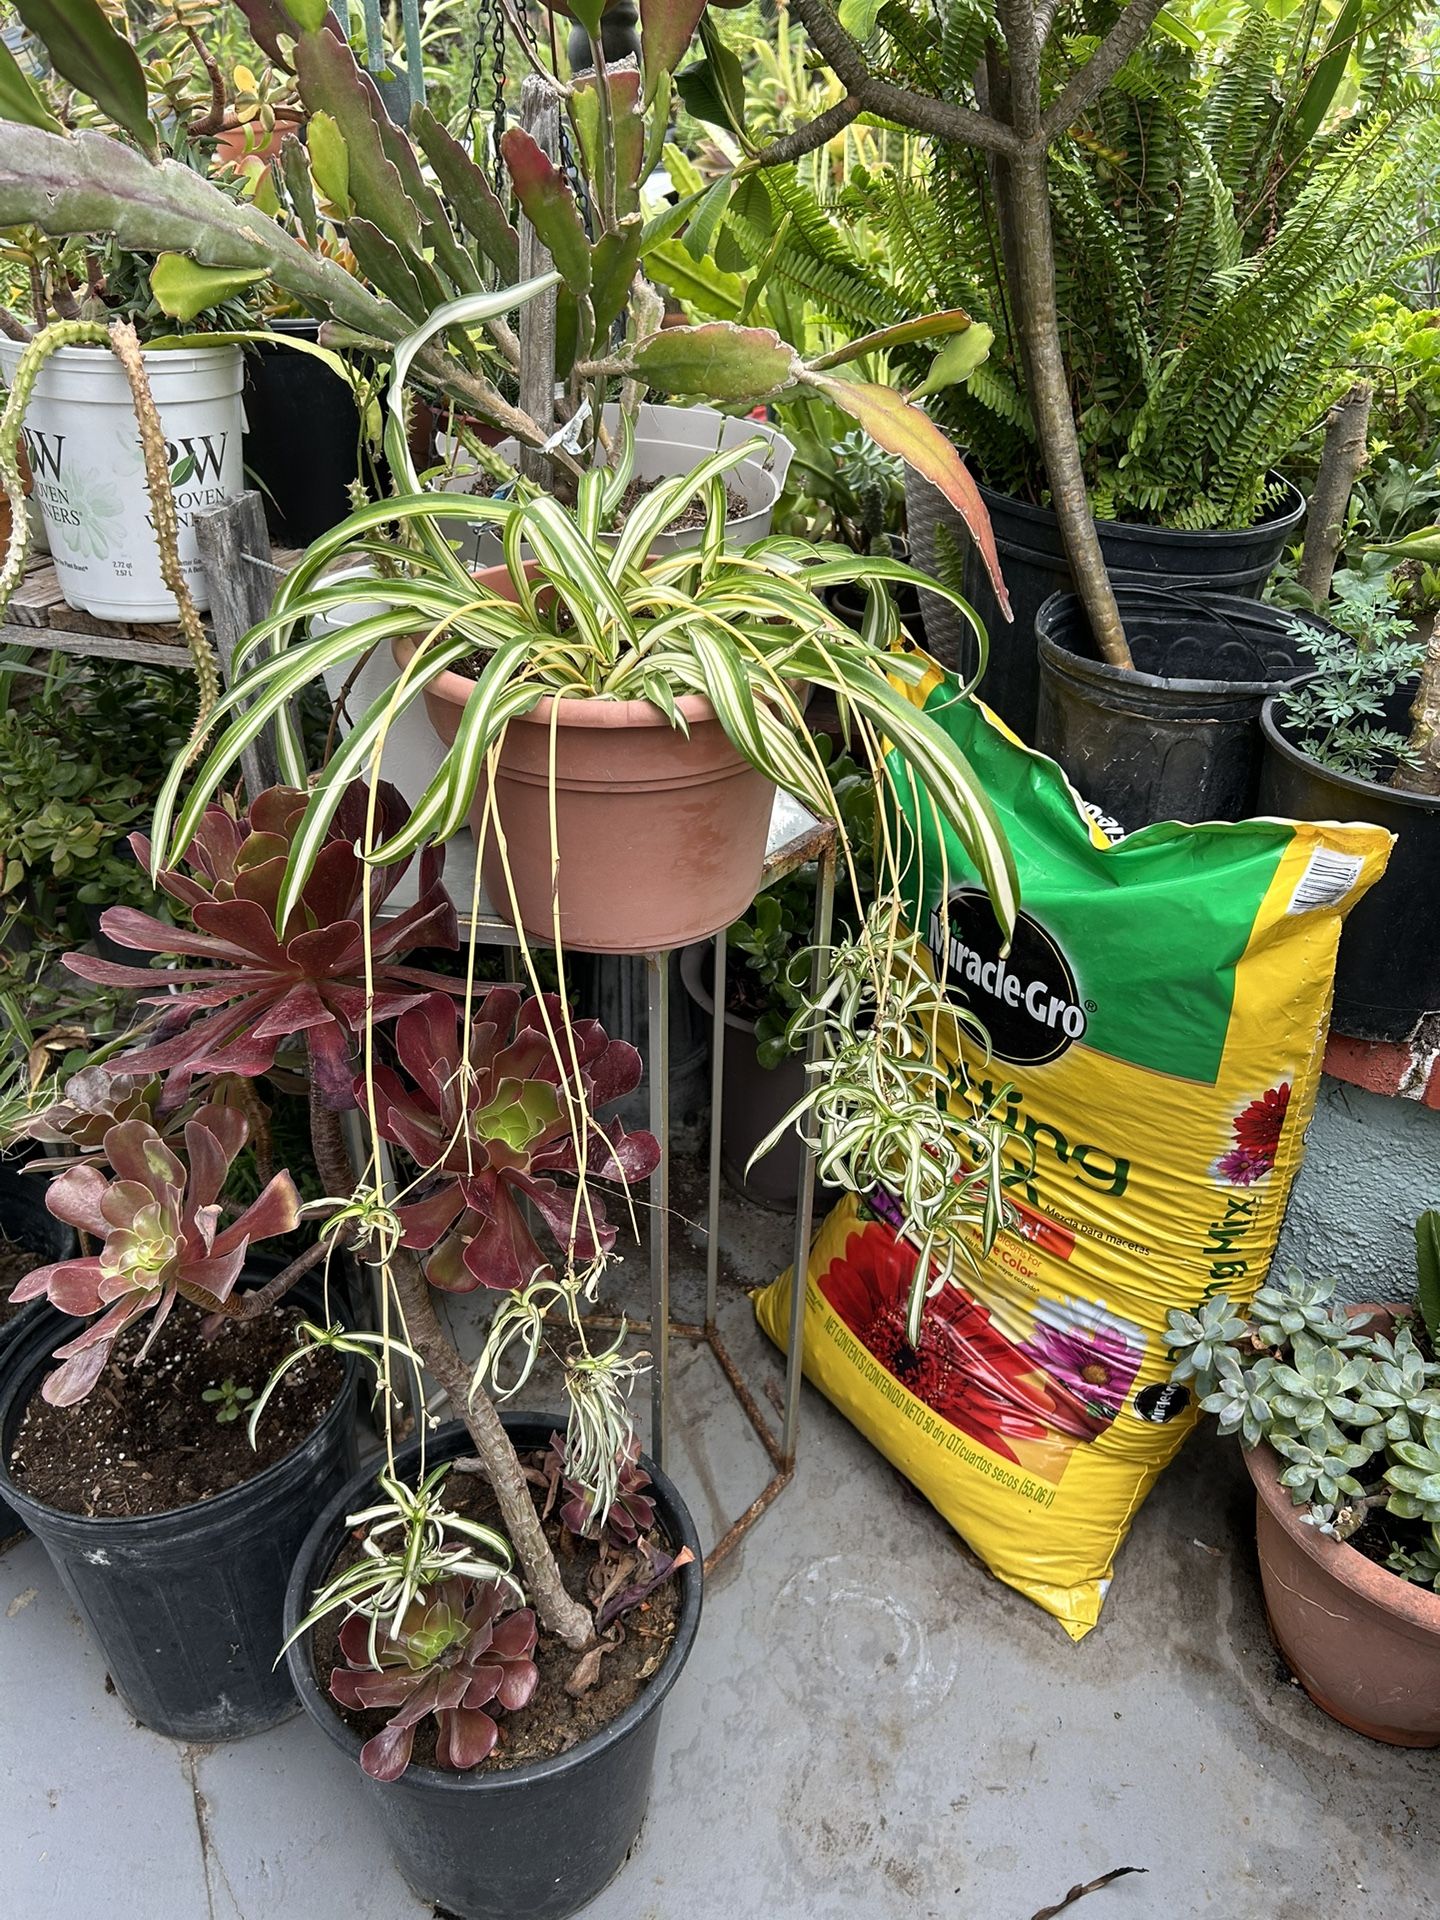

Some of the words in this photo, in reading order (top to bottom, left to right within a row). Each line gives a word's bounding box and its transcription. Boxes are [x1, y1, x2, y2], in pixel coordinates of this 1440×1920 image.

[1044, 1204, 1078, 1228] Mezcla
[1080, 1223, 1104, 1240] para
[1105, 1233, 1151, 1256] macetas
[1203, 1198, 1252, 1254] Mix
[1027, 1252, 1042, 1268] For
[823, 1315, 839, 1335] NET
[836, 1328, 905, 1409] CONTENTS/CONTENIDO
[902, 1399, 925, 1425] NETO
[922, 1415, 935, 1434] 50
[933, 1425, 947, 1447] dry
[945, 1434, 993, 1474] QT/cuartos
[991, 1465, 1020, 1490] secos
[1017, 1477, 1046, 1504] (55.06
